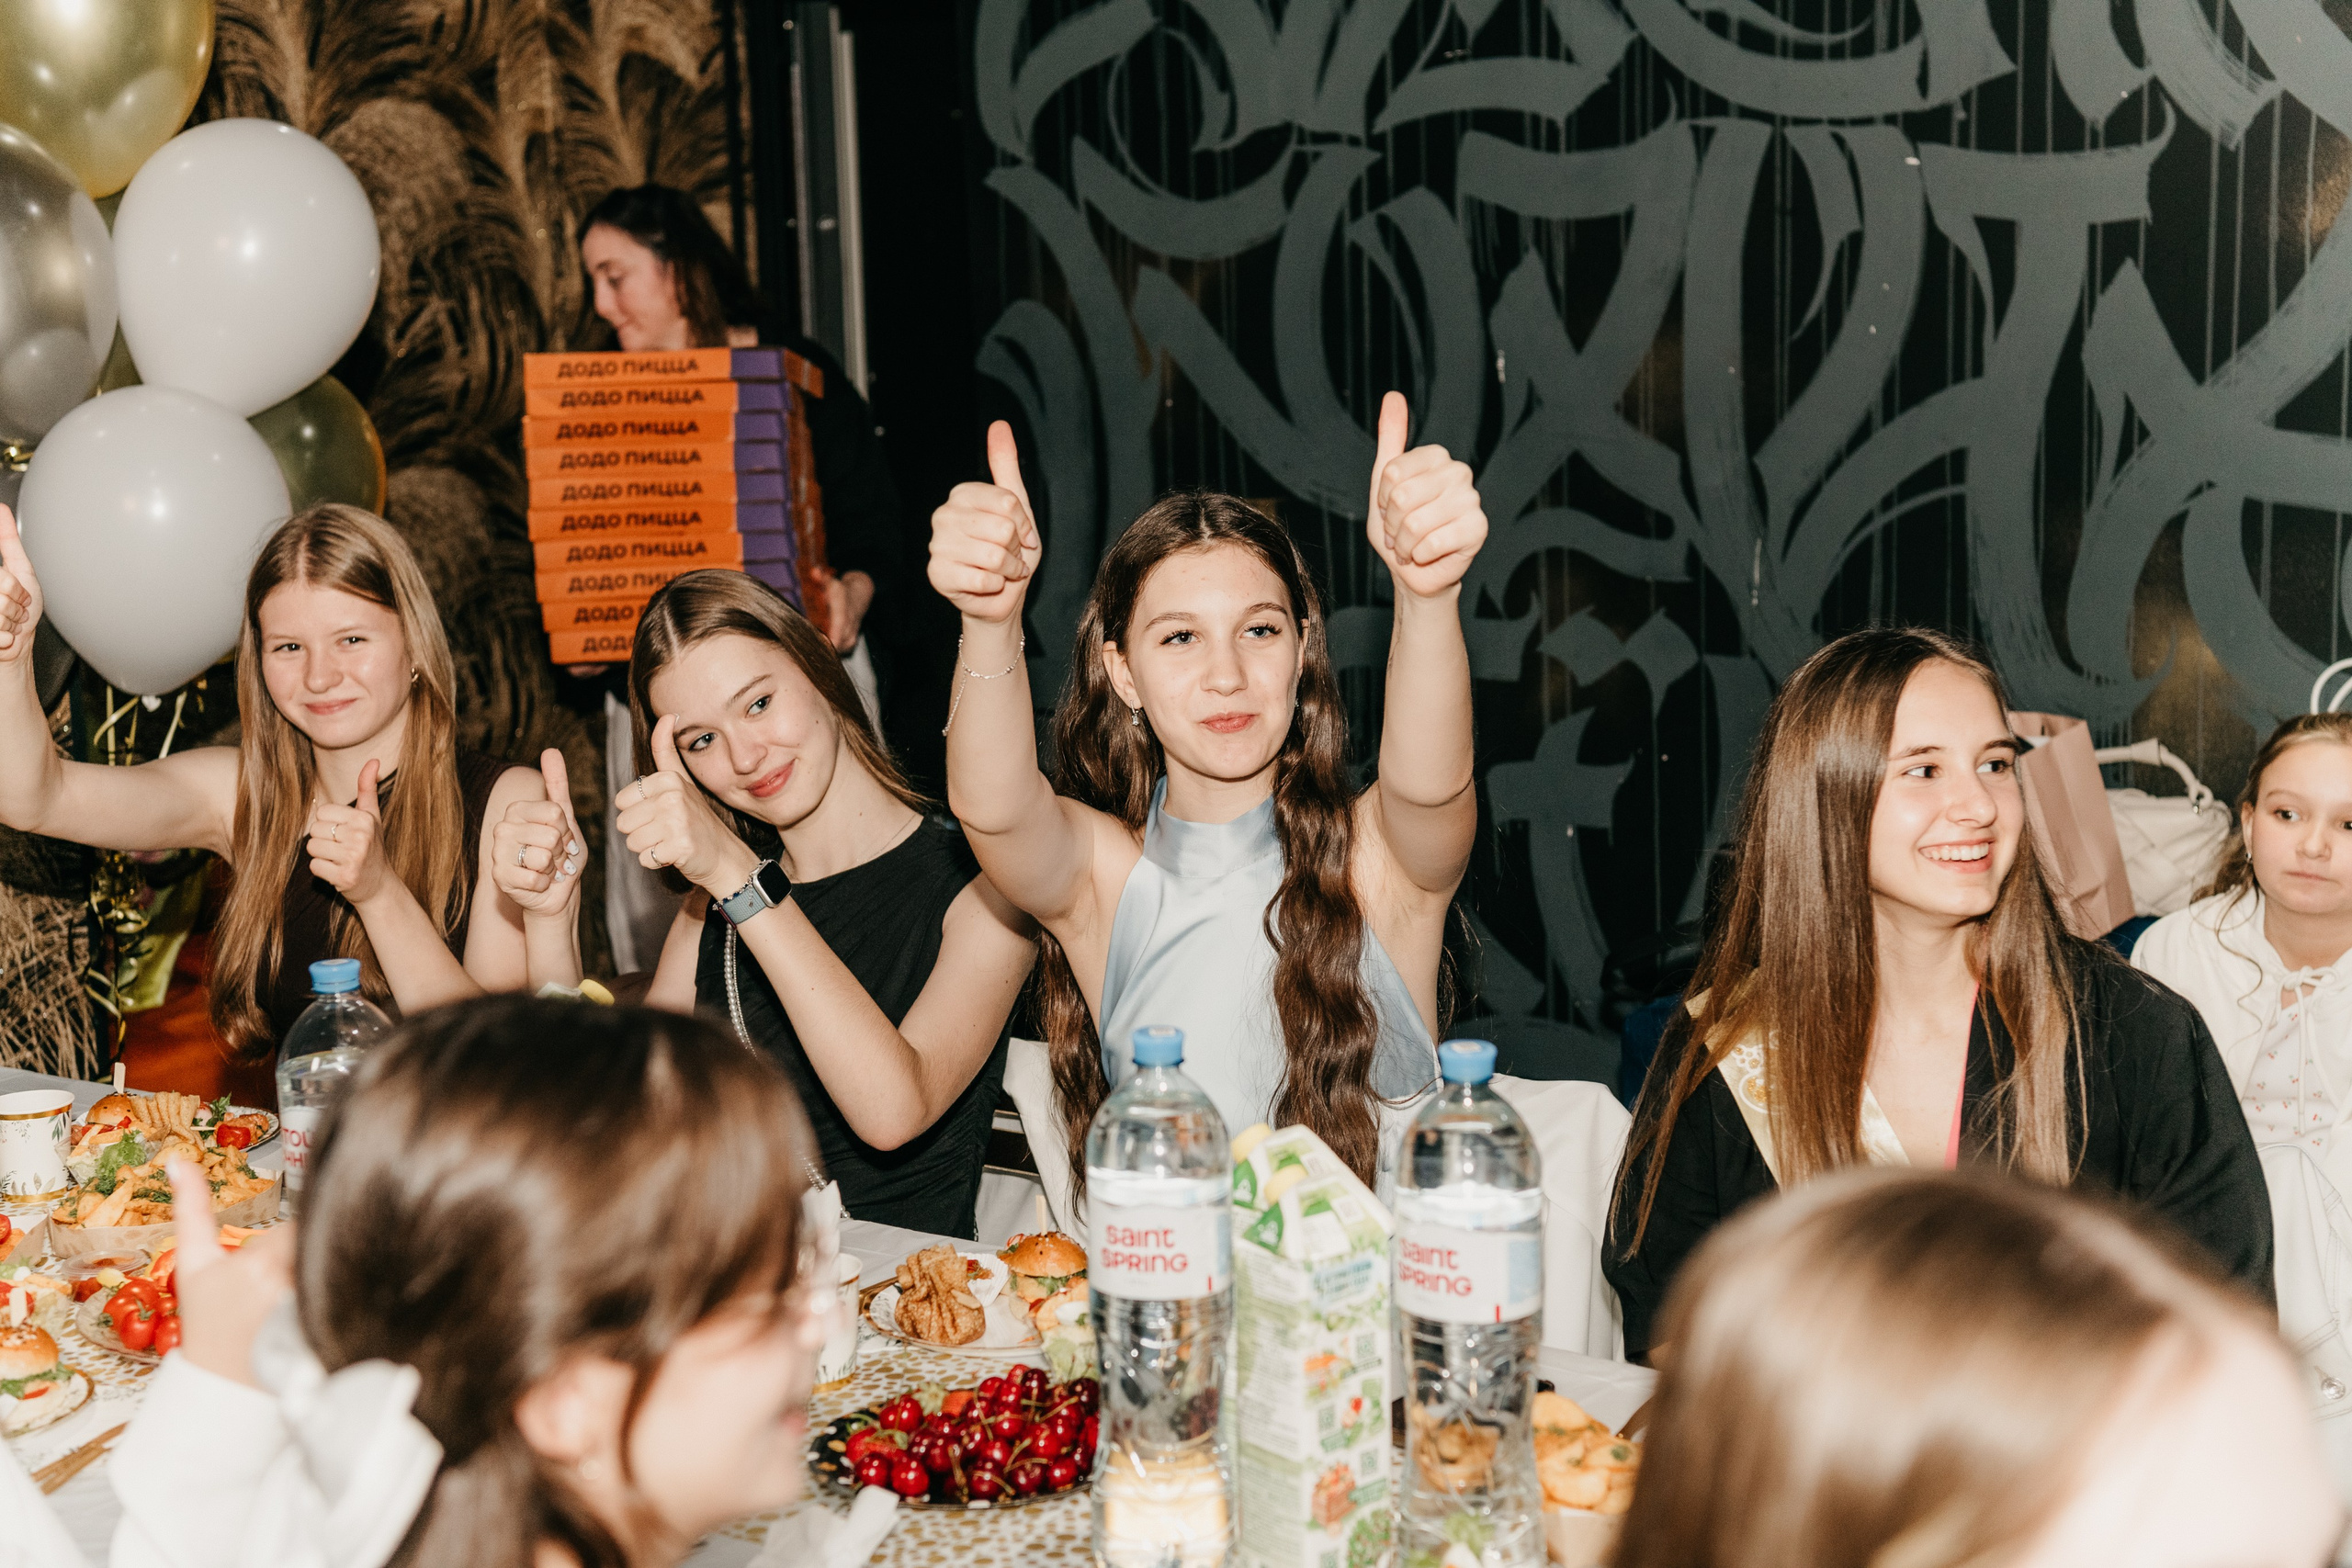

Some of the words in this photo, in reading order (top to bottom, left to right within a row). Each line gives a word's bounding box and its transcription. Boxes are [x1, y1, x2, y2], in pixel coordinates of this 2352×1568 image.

[557, 362, 618, 378] ДОДО
[622, 359, 700, 374] ПИЦЦА
[560, 391, 622, 408] ДОДО
[626, 389, 705, 404] ПИЦЦА
[556, 423, 618, 440] ДОДО
[622, 421, 700, 435] ПИЦЦА
[559, 452, 621, 469] ДОДО
[625, 450, 702, 465] ПИЦЦА
[561, 484, 623, 502] ДОДО
[627, 481, 703, 497] ПИЦЦА
[560, 513, 622, 532] ДОДО
[625, 512, 702, 526] ПИЦЦА
[566, 544, 627, 562] ДОДО
[631, 541, 707, 557] ПИЦЦА
[568, 574, 629, 593] ДОДО
[573, 605, 635, 625] ДОДО
